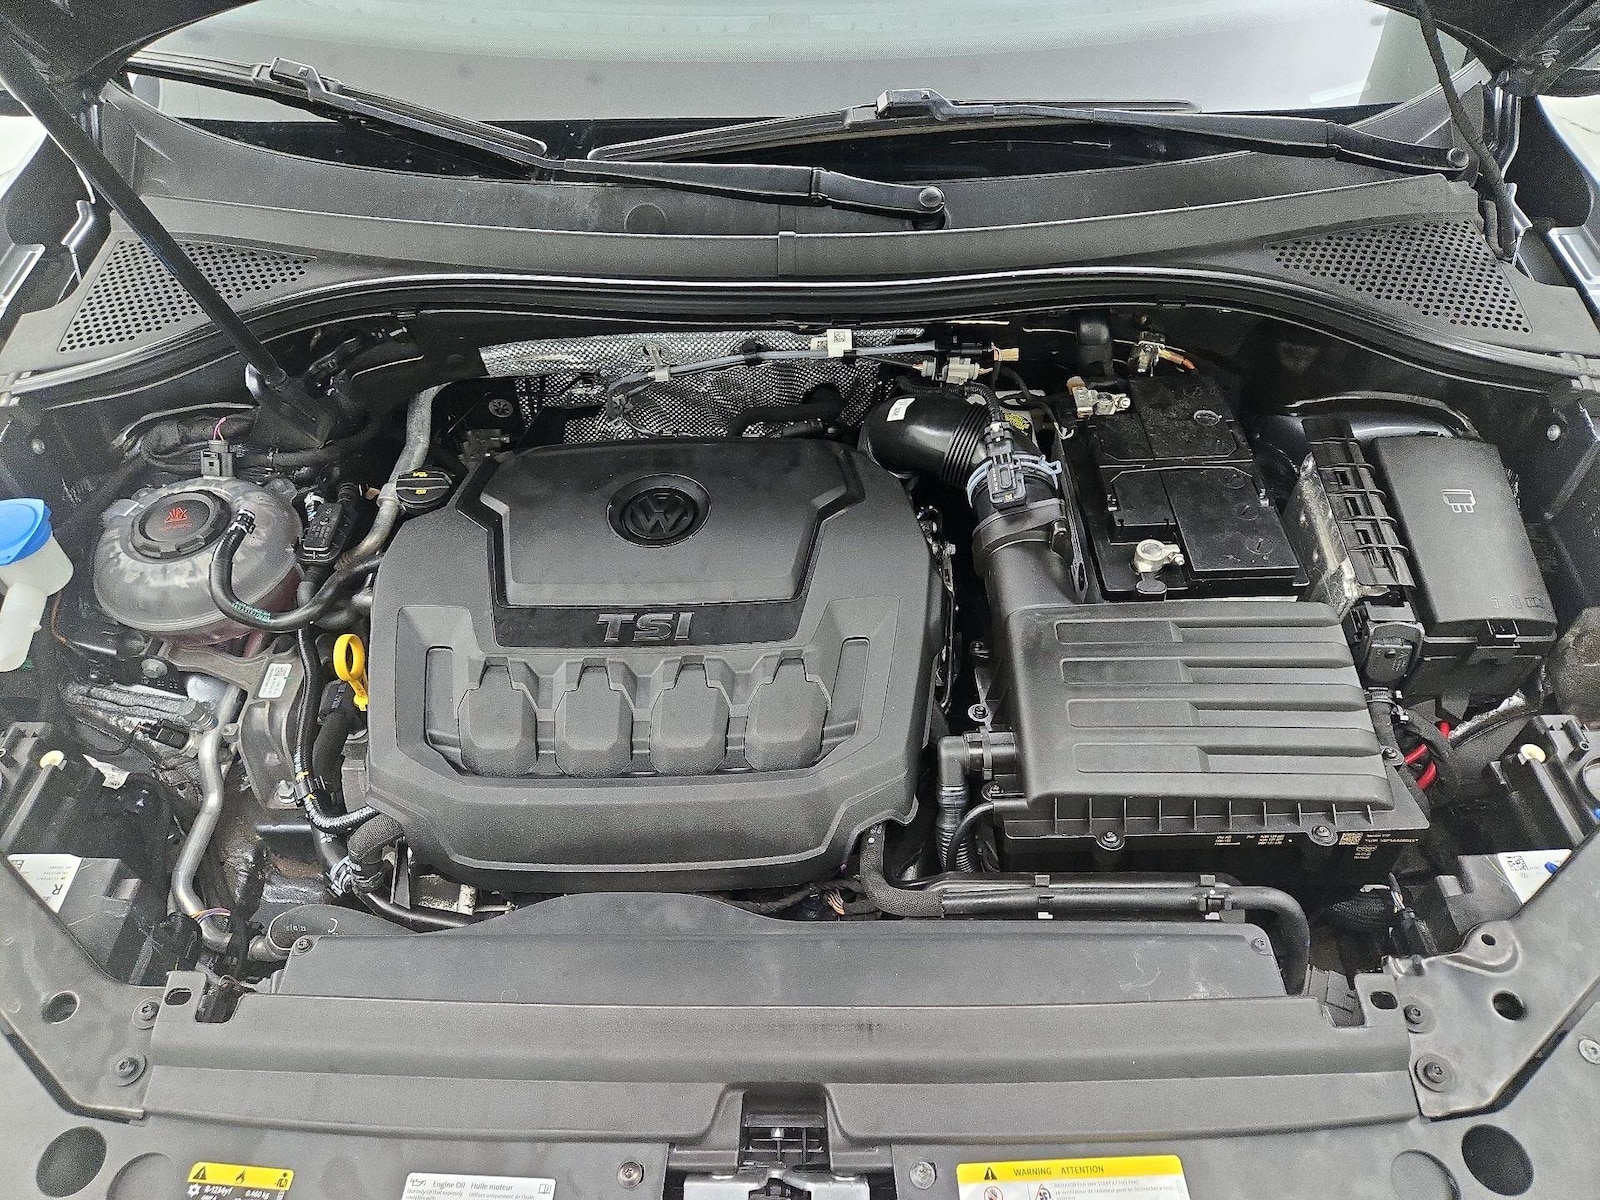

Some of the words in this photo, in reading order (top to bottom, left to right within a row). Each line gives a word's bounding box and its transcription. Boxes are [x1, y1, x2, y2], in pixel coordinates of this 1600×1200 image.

[597, 611, 695, 642] TSI
[1013, 1167, 1052, 1177] WARNING
[1060, 1165, 1105, 1175] ATTENTION
[433, 1180, 455, 1190] Engine
[471, 1182, 488, 1190] Huile
